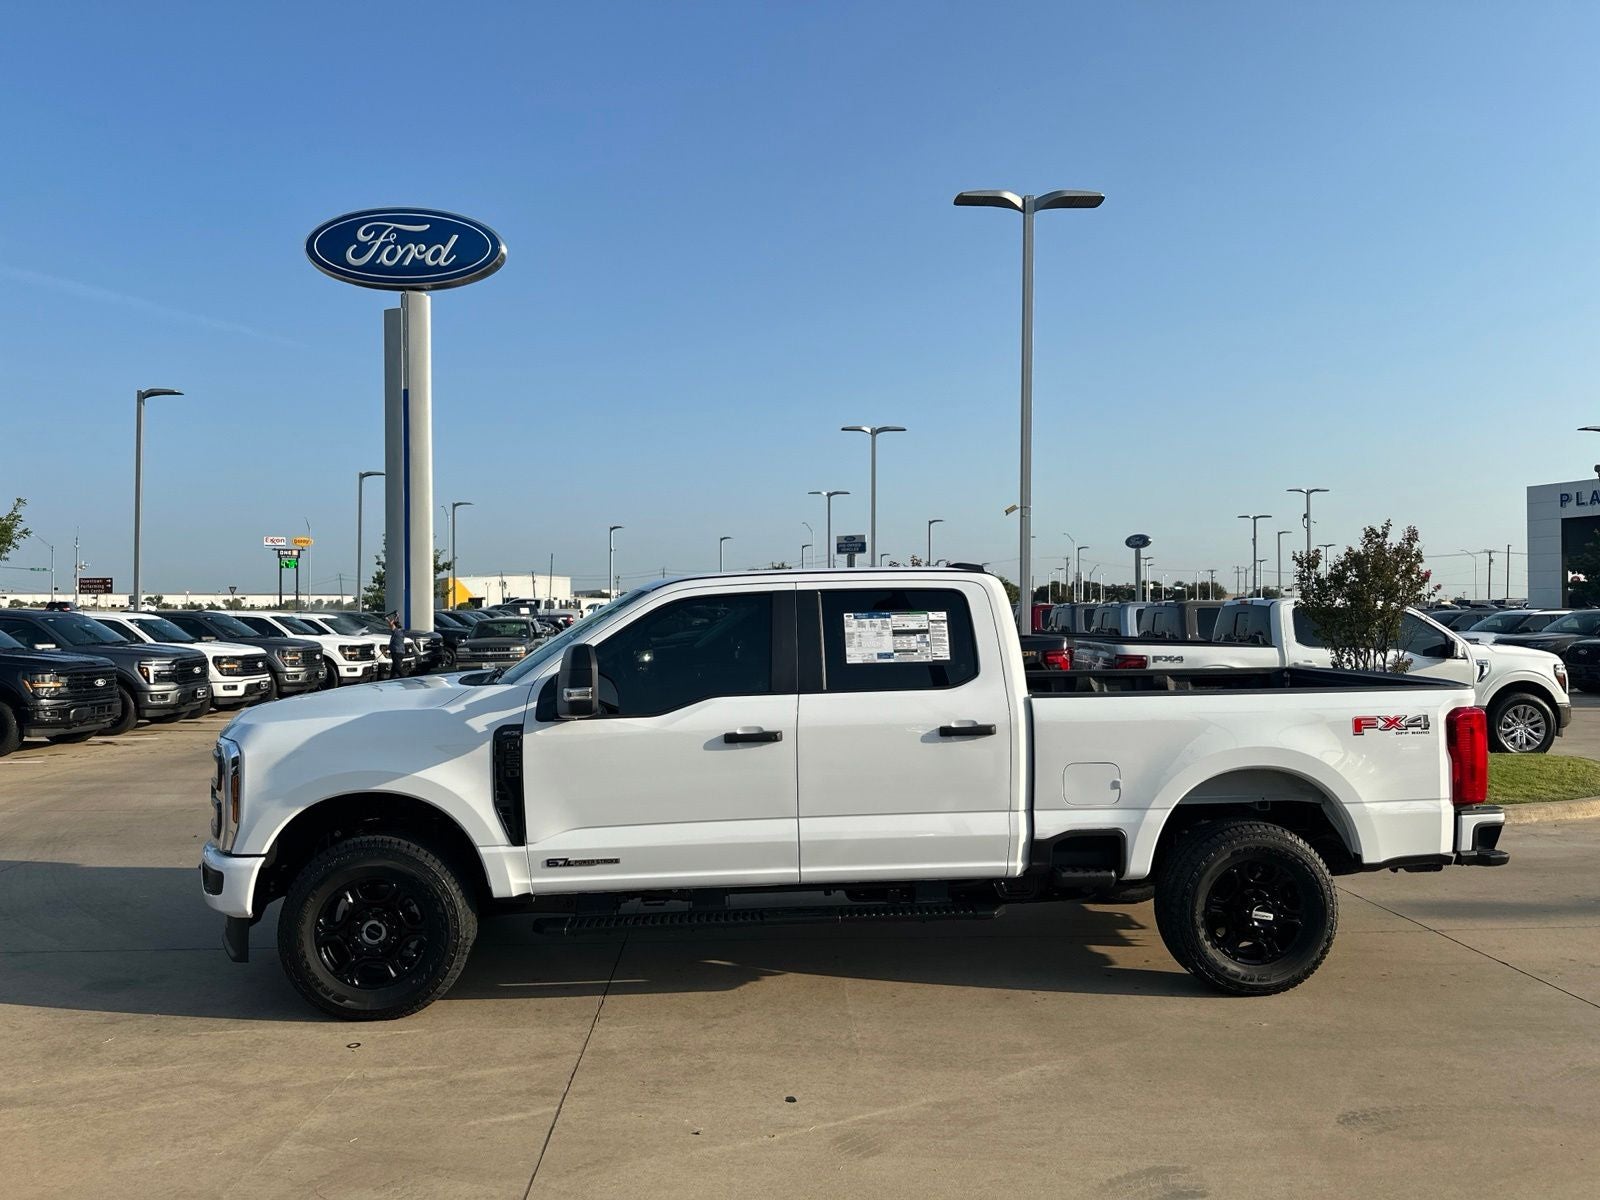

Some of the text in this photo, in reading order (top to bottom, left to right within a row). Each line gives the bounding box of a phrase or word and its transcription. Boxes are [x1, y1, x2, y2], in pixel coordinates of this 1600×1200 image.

[345, 221, 459, 267] Ford
[1560, 490, 1600, 508] PLA
[265, 536, 285, 545] Exxon
[1152, 655, 1185, 664] FX4
[1352, 714, 1430, 736] FX4
